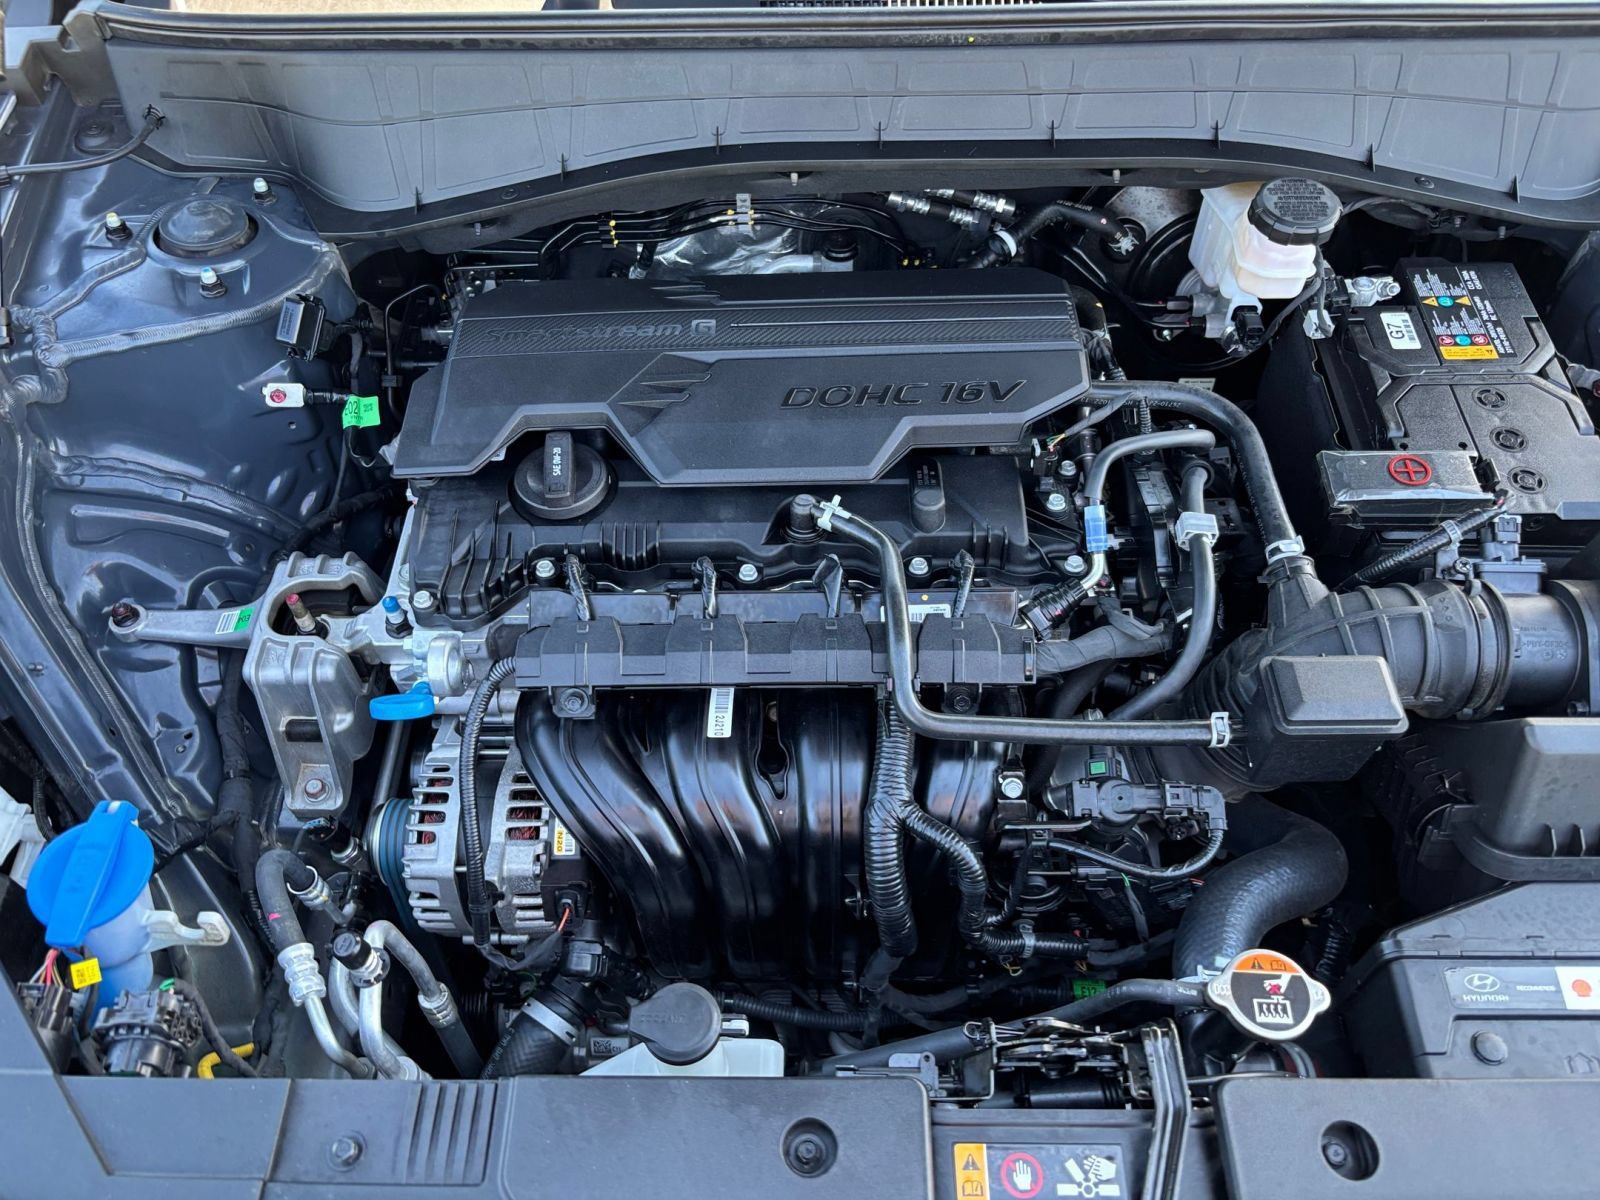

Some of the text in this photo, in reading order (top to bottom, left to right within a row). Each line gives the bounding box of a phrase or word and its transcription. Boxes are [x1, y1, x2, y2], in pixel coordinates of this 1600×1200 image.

[481, 322, 683, 342] Smartstream
[1386, 322, 1405, 339] G7
[780, 379, 1027, 409] DOHC 16V
[1463, 994, 1510, 1002] HYUNDAI
